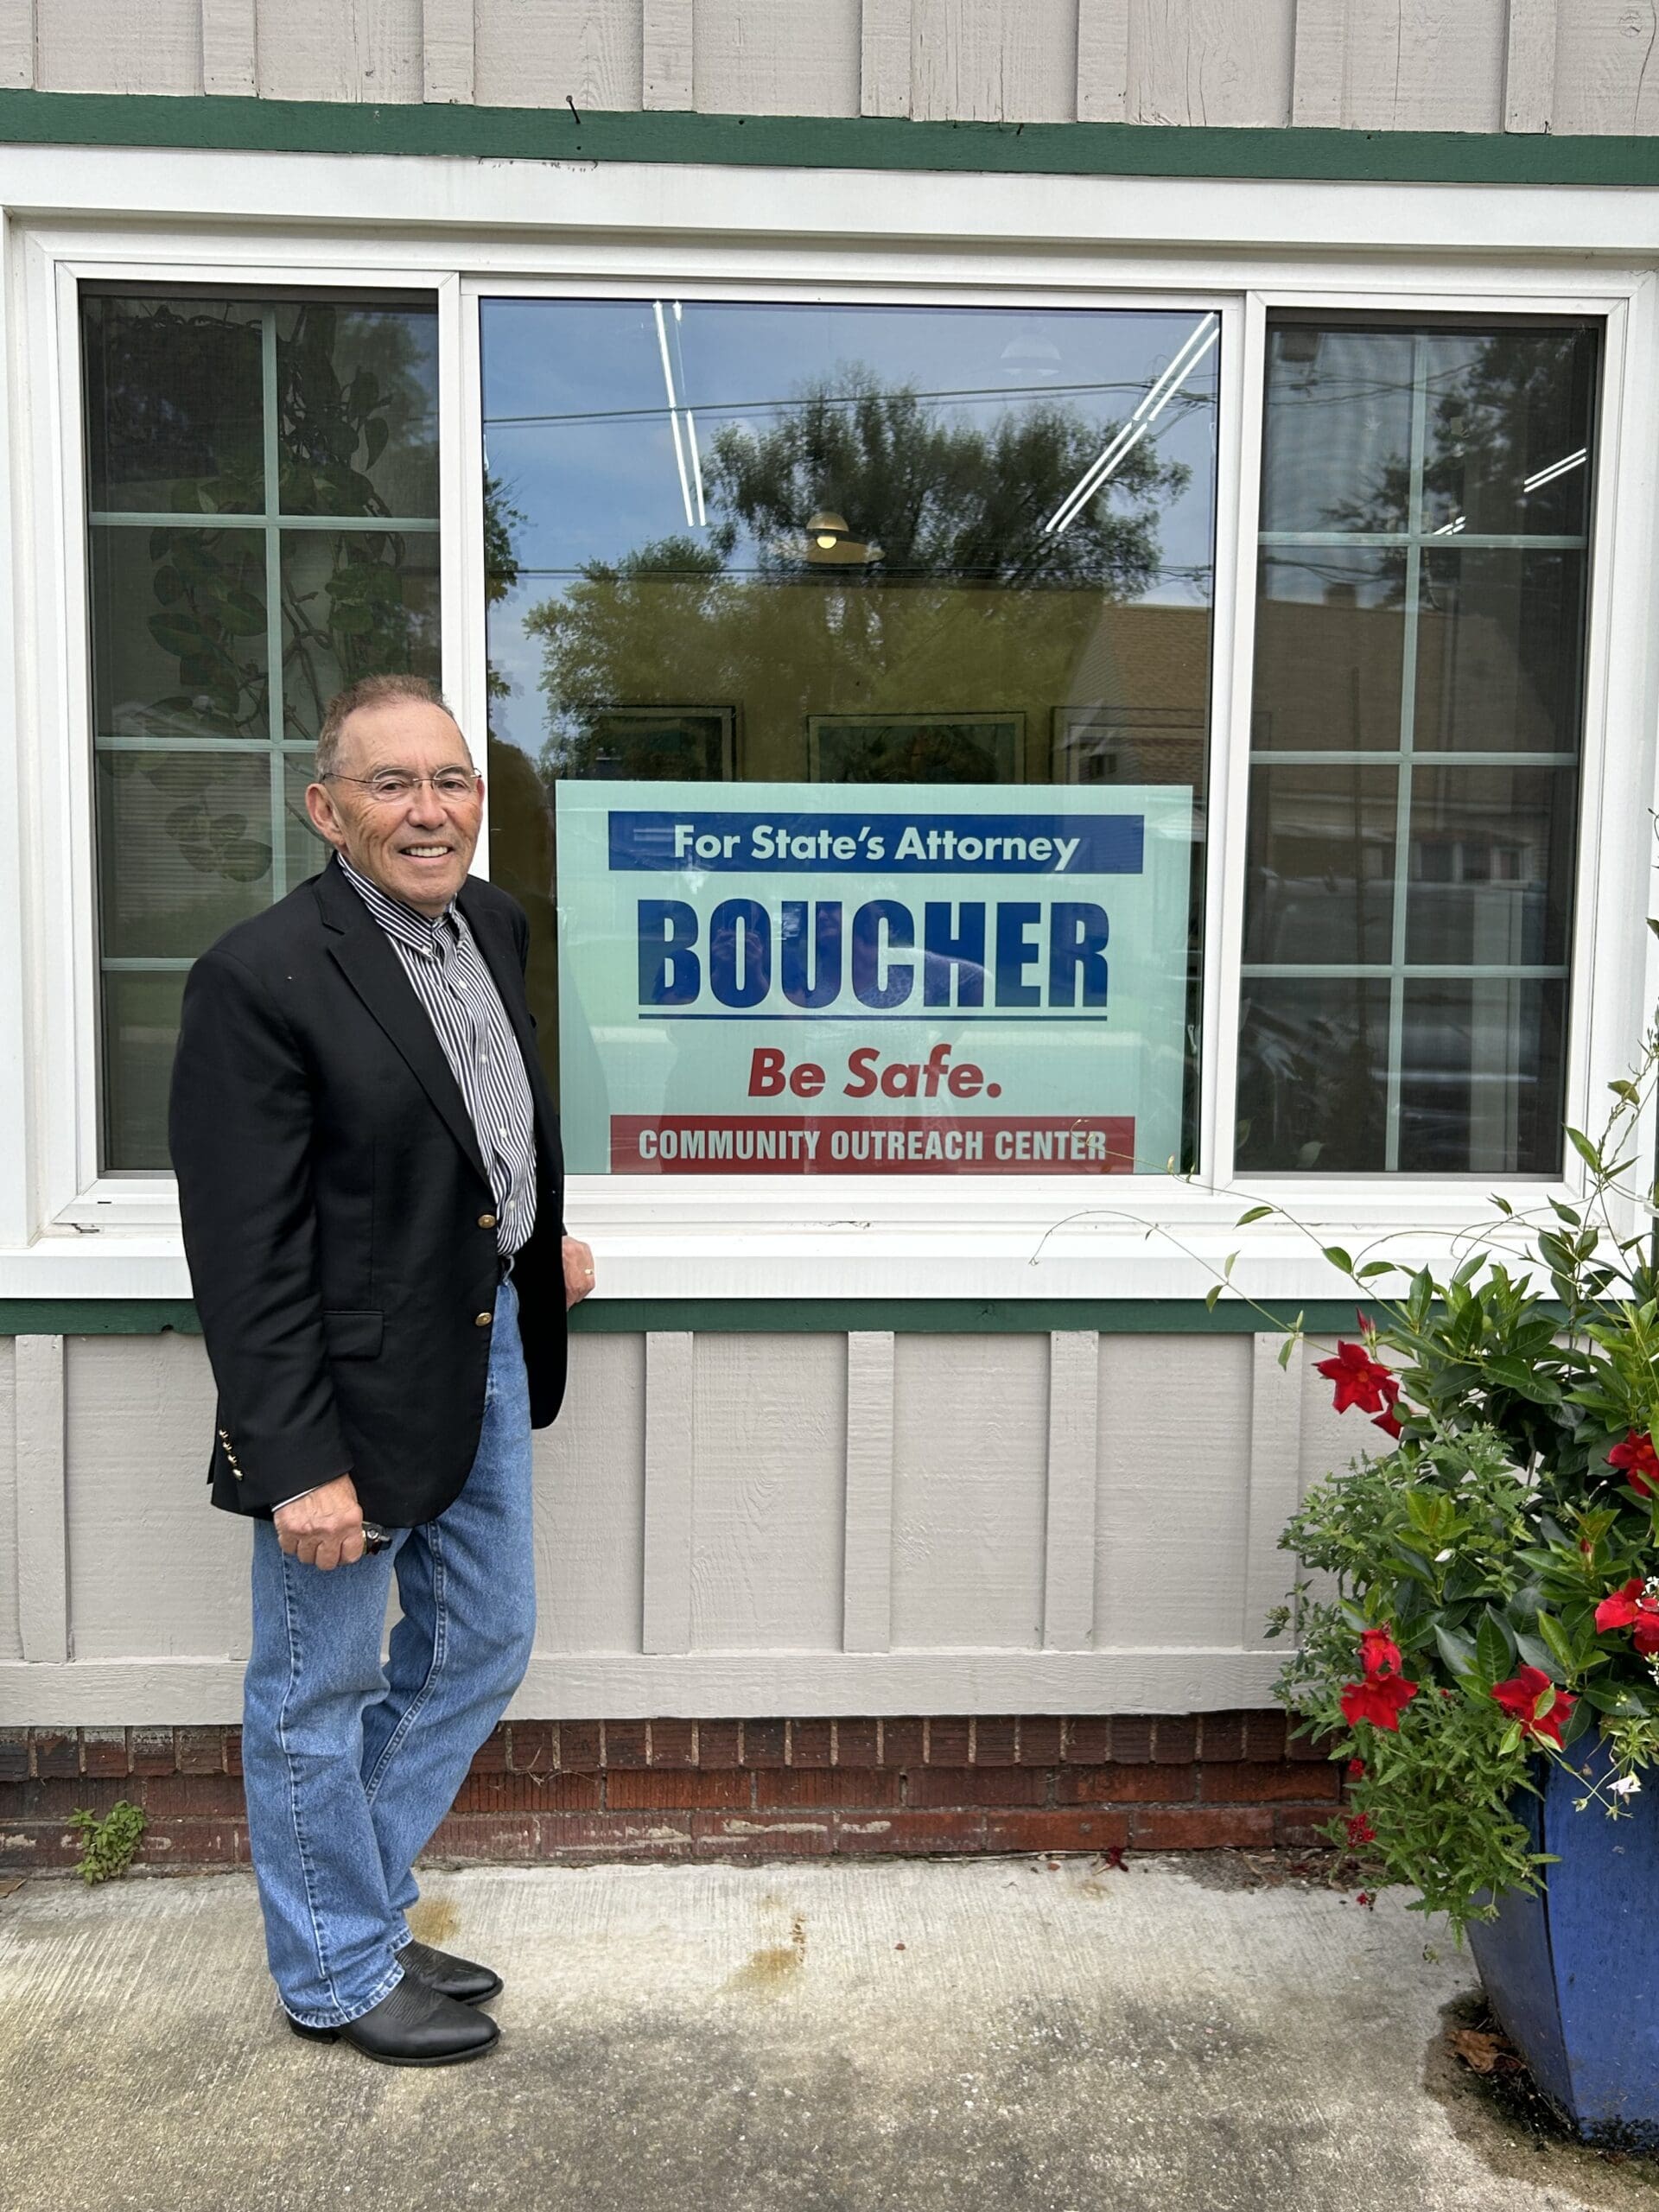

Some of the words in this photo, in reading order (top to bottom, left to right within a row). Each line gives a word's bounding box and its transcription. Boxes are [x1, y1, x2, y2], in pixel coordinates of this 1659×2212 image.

[674, 824, 741, 860] For
[751, 825, 885, 861] State's
[894, 825, 1081, 871] Attorney
[637, 899, 1110, 1009] BOUCHER
[747, 1047, 826, 1098] Be
[842, 1044, 1003, 1099] Safe.
[639, 1129, 821, 1161] COMMUNITY
[830, 1130, 981, 1161] OUTREACH
[995, 1130, 1108, 1161] CENTER
